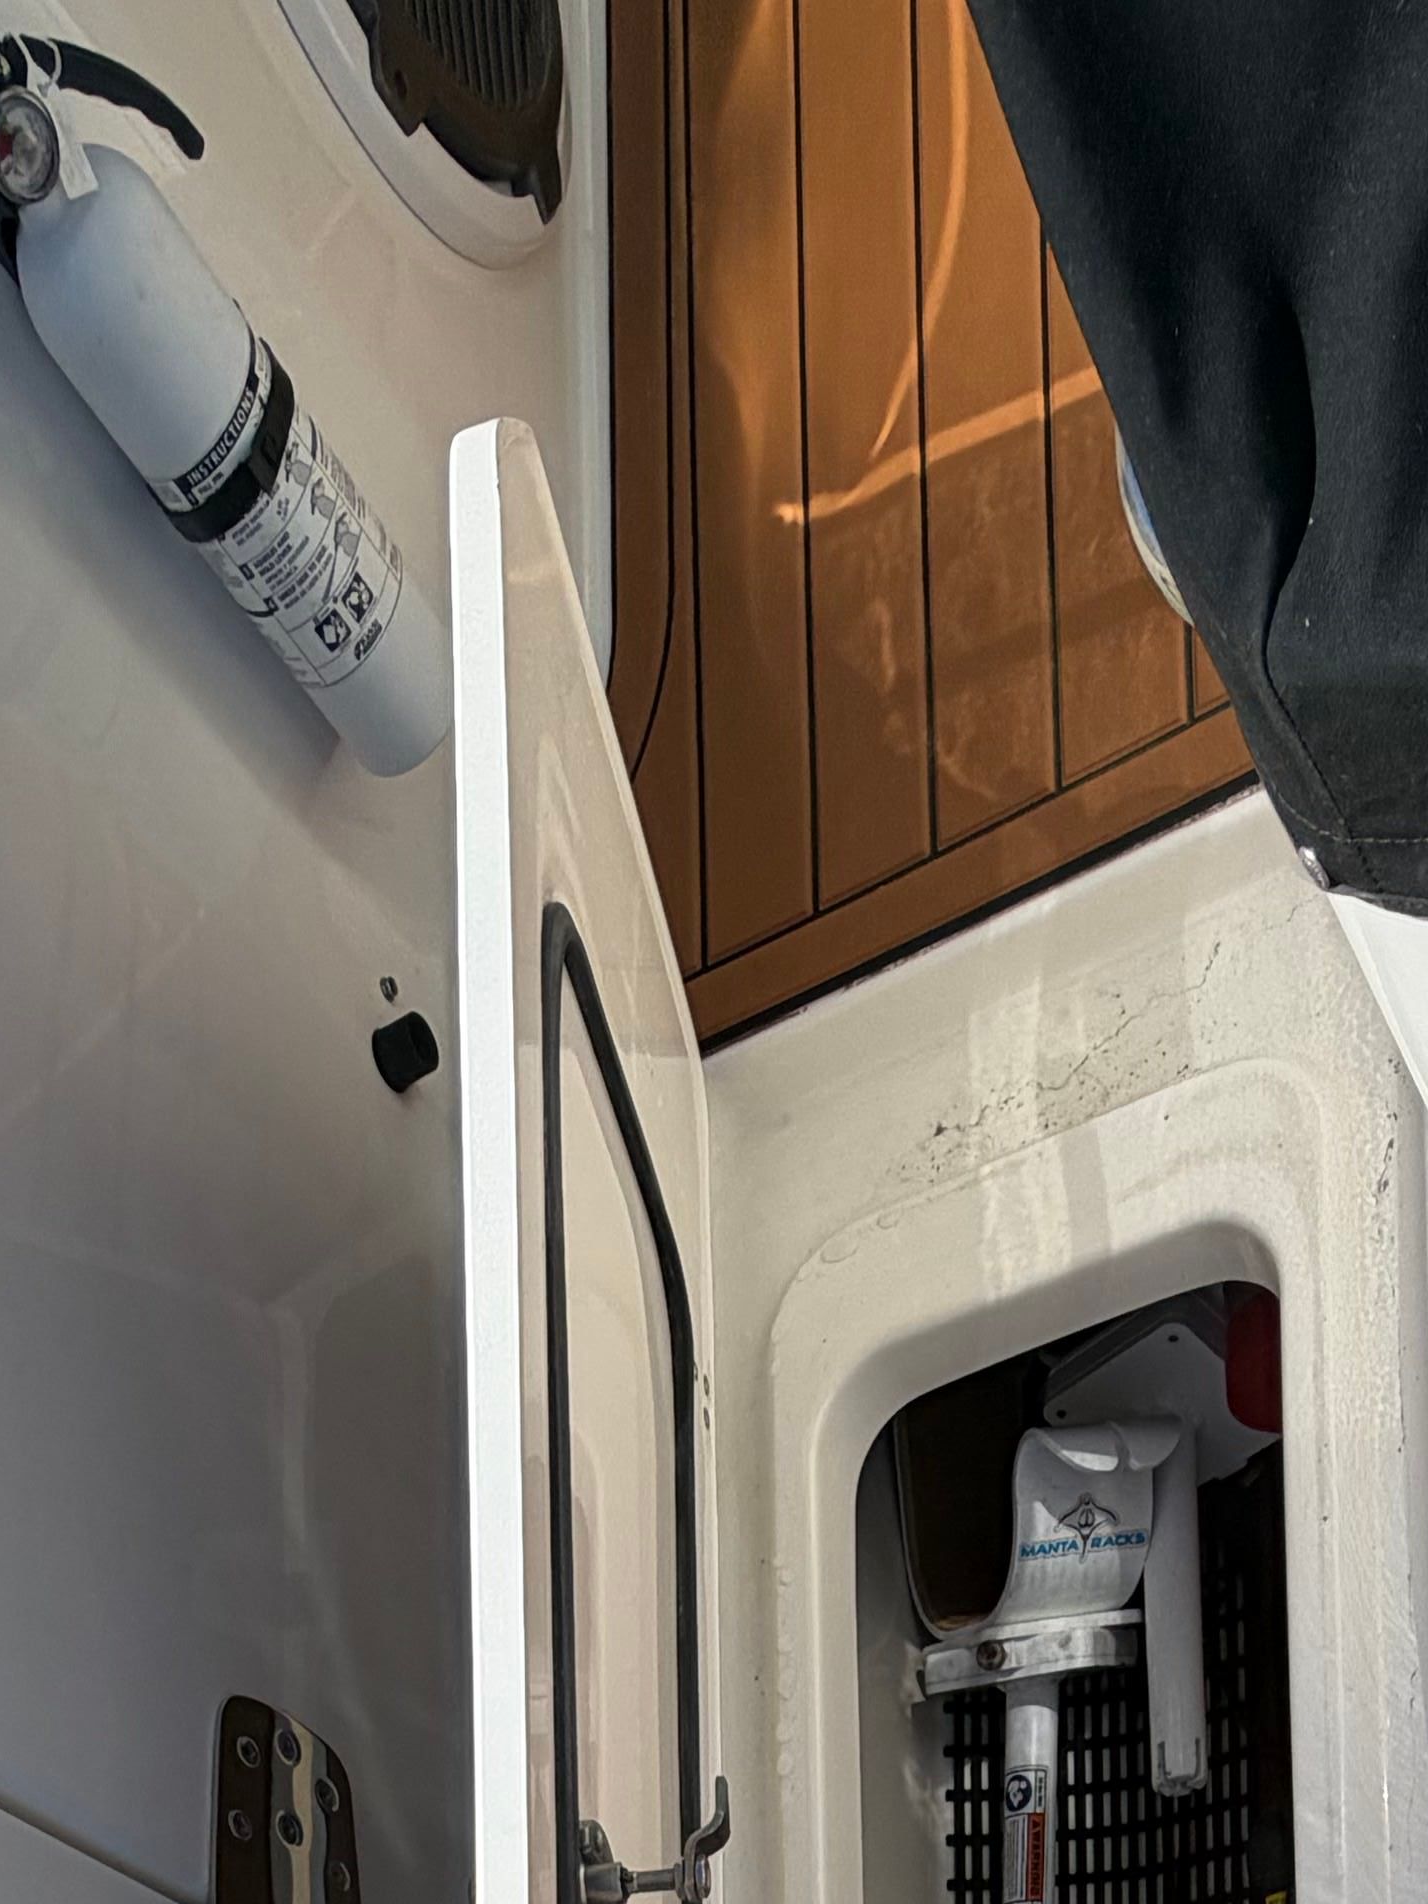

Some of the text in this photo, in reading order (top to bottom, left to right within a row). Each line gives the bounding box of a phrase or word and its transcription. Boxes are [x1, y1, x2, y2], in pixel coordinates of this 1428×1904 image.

[186, 386, 254, 487] INSTRUCTIONS
[1021, 1532, 1145, 1557] MANTA RACKS
